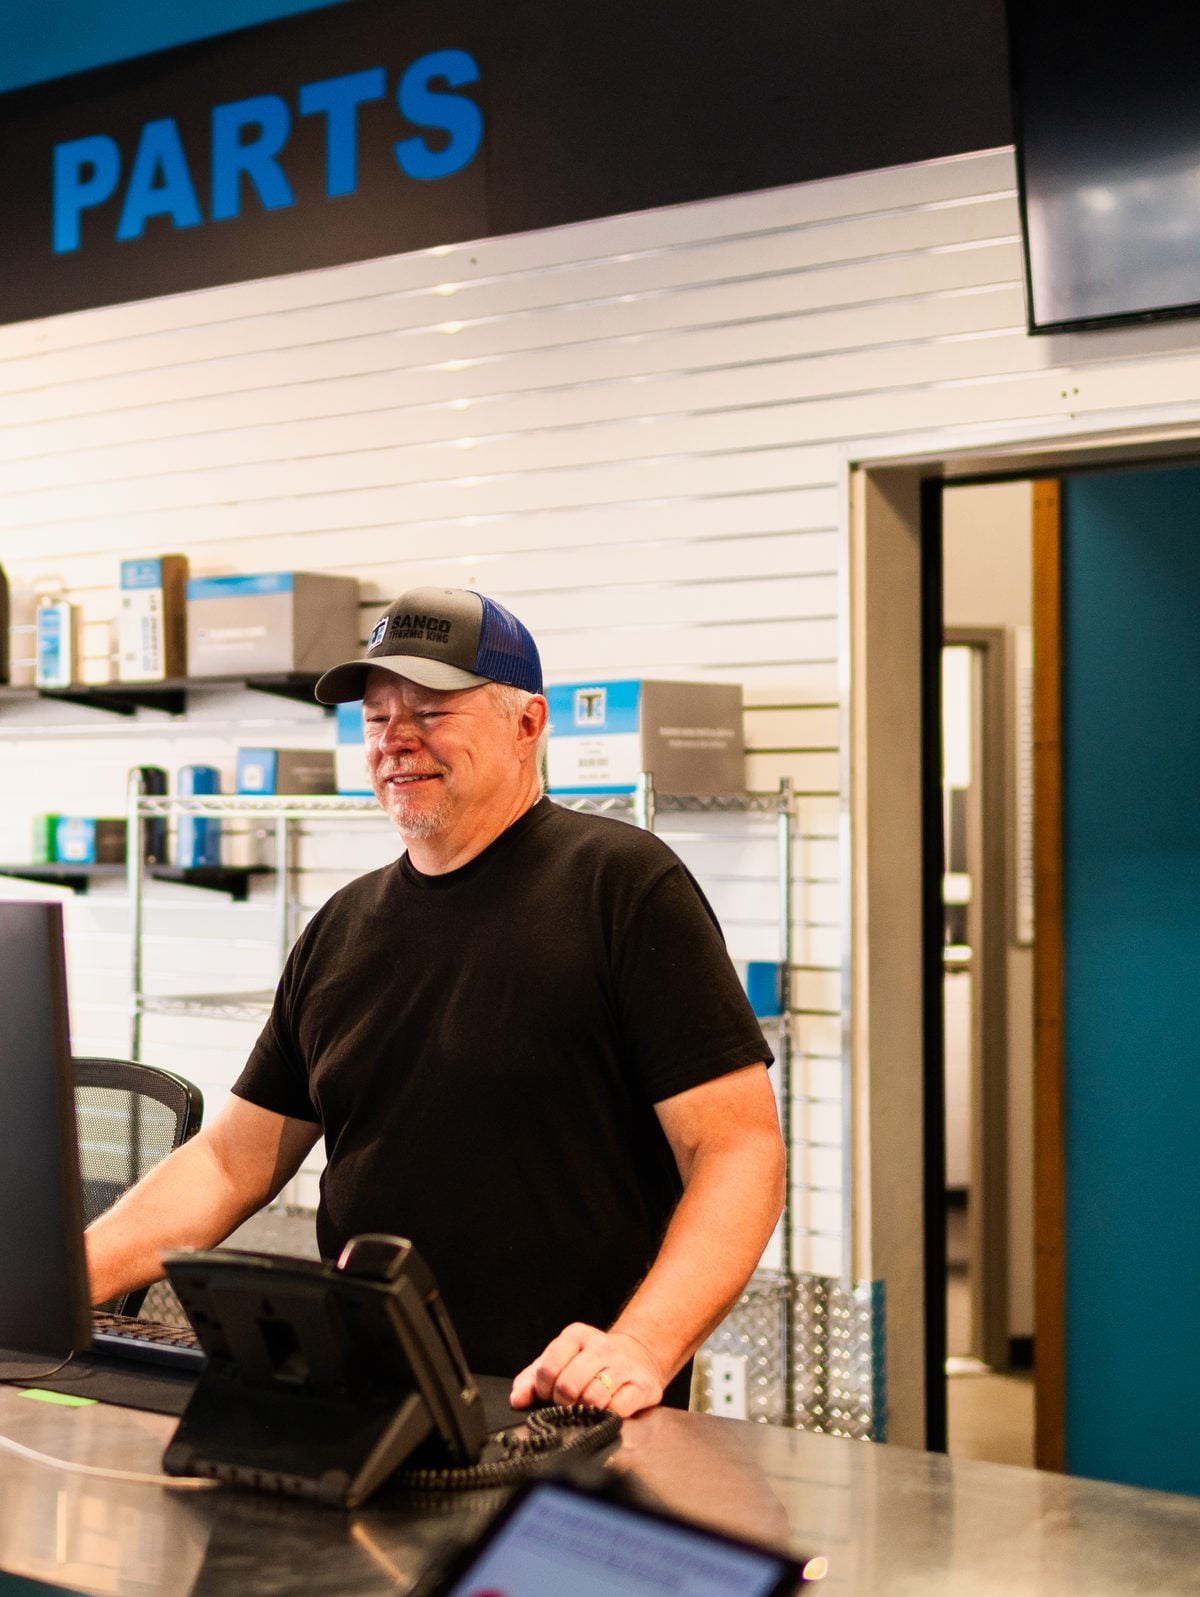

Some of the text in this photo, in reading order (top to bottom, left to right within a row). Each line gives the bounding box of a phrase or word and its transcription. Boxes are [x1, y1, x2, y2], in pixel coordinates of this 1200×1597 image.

[53, 48, 484, 255] PARTS
[391, 614, 452, 633] SANCO
[389, 628, 449, 643] THERMO KING
